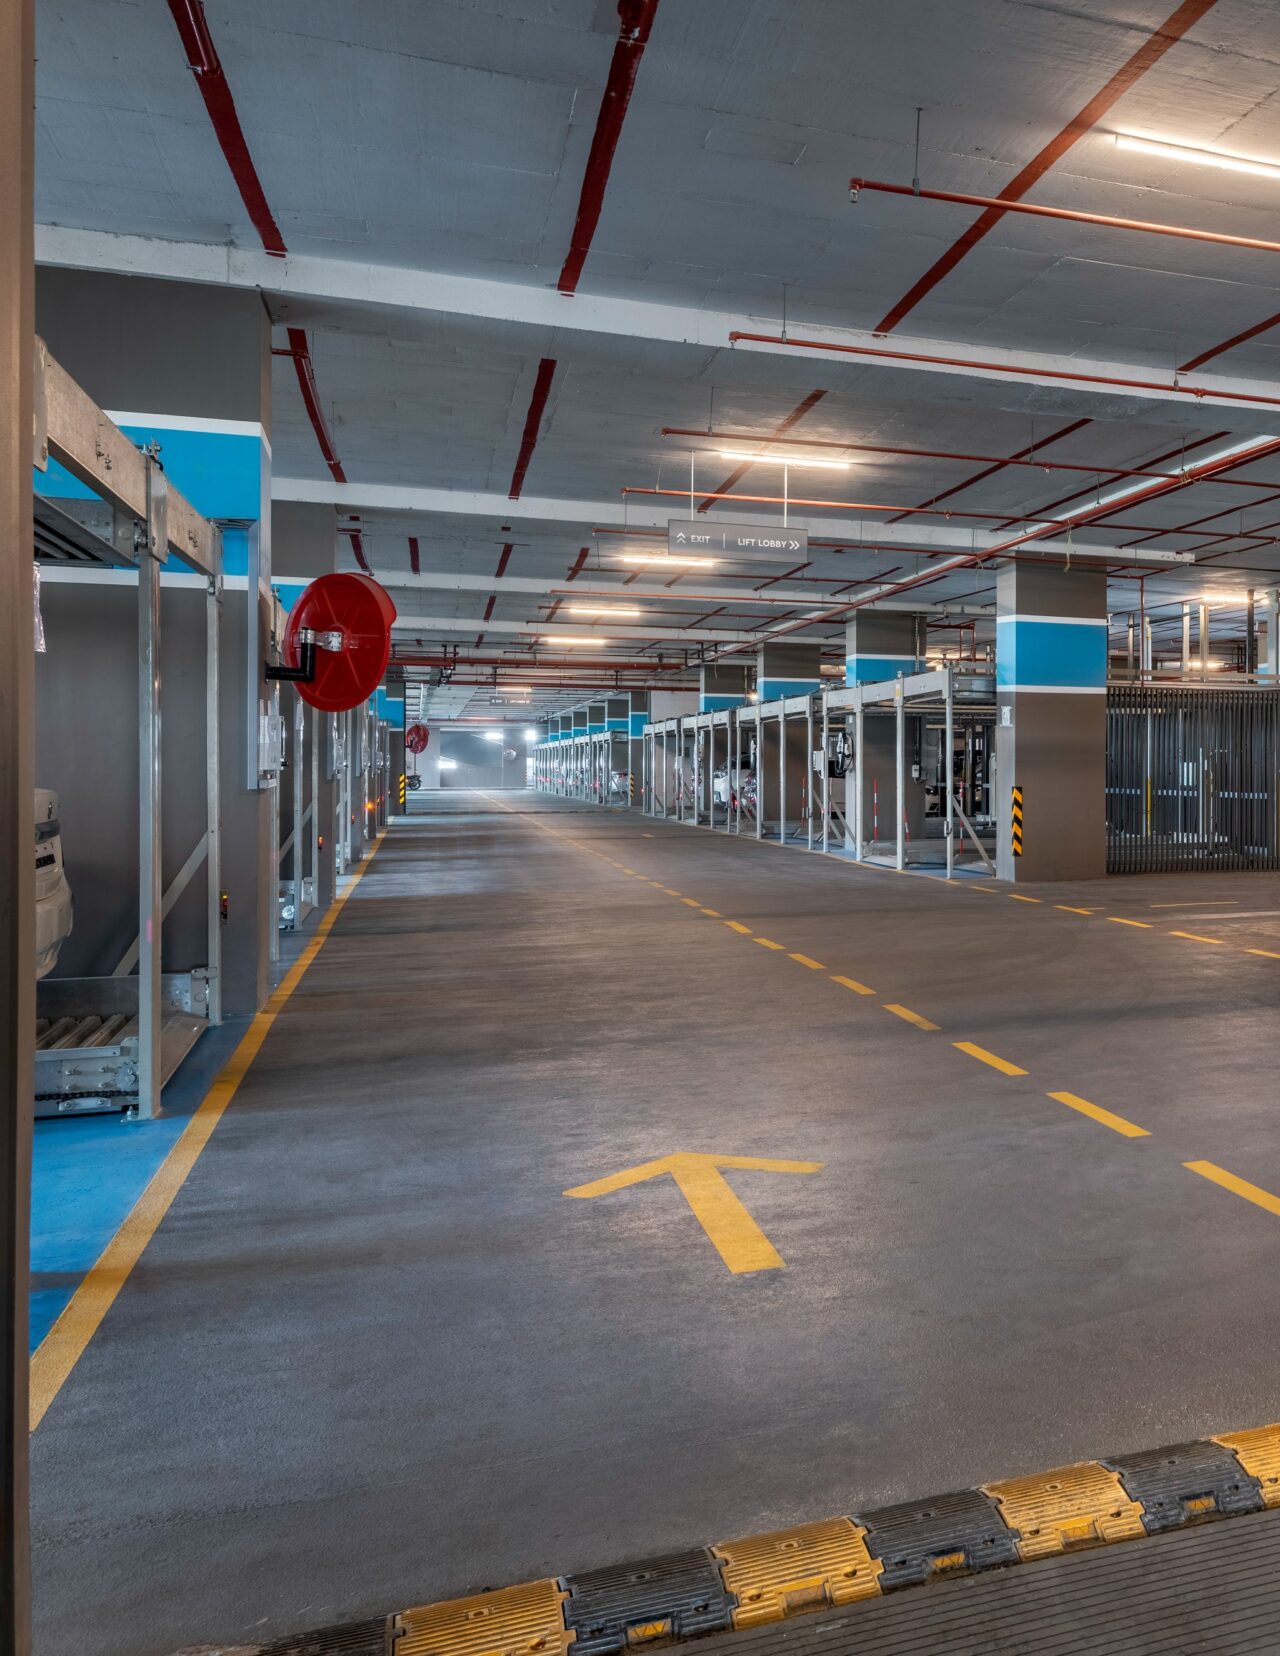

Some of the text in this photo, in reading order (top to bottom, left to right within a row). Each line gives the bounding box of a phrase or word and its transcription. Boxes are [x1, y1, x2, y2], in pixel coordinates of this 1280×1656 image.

[691, 535, 711, 544] EXIT
[738, 538, 787, 548] LIFT LOBBY
